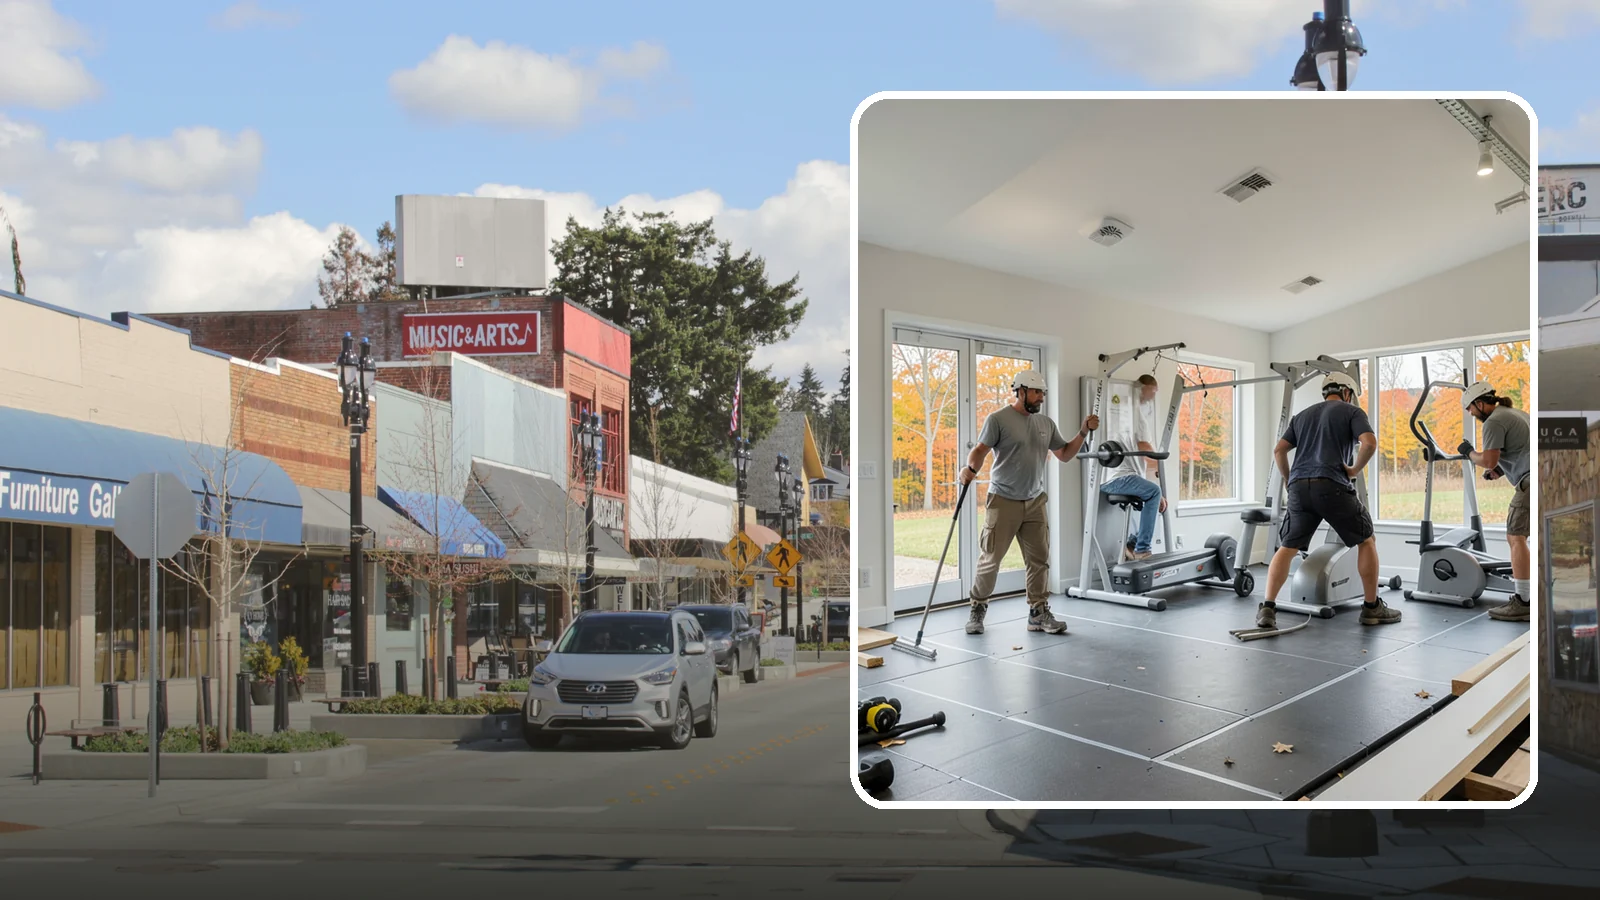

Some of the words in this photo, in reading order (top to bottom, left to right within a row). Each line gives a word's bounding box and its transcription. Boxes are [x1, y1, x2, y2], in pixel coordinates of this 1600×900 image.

[409, 323, 520, 348] MUSIC&ARTS
[1540, 427, 1578, 437] UGA
[0, 471, 80, 515] Furniture
[89, 482, 122, 520] Gal
[453, 563, 480, 575] SUSHI
